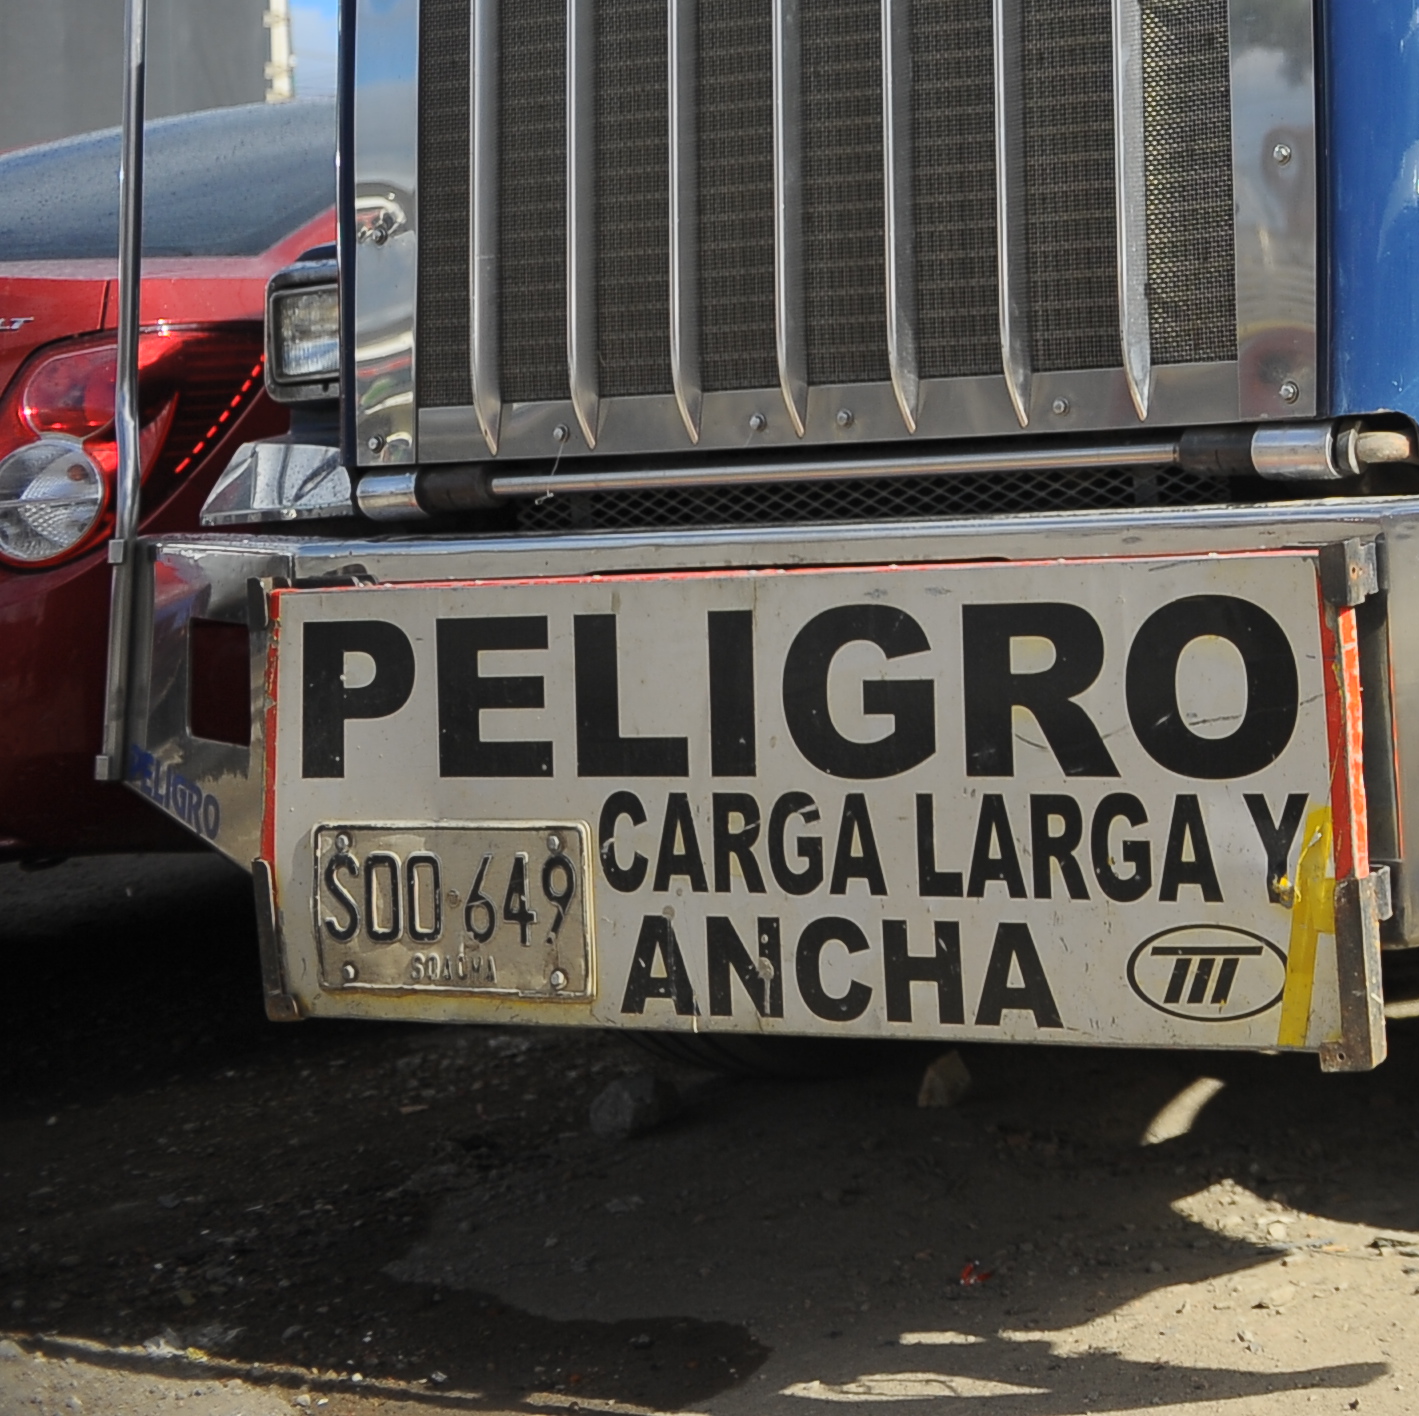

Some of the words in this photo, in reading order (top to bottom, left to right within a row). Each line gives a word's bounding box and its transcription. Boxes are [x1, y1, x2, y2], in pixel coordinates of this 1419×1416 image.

[300, 594, 1299, 780] PELIGRO
[464, 851, 577, 946] 649
[598, 790, 888, 896] CARGA
[915, 792, 1224, 903] LARGA
[1242, 792, 1309, 905] Y
[620, 915, 1064, 1029] ANCHA
